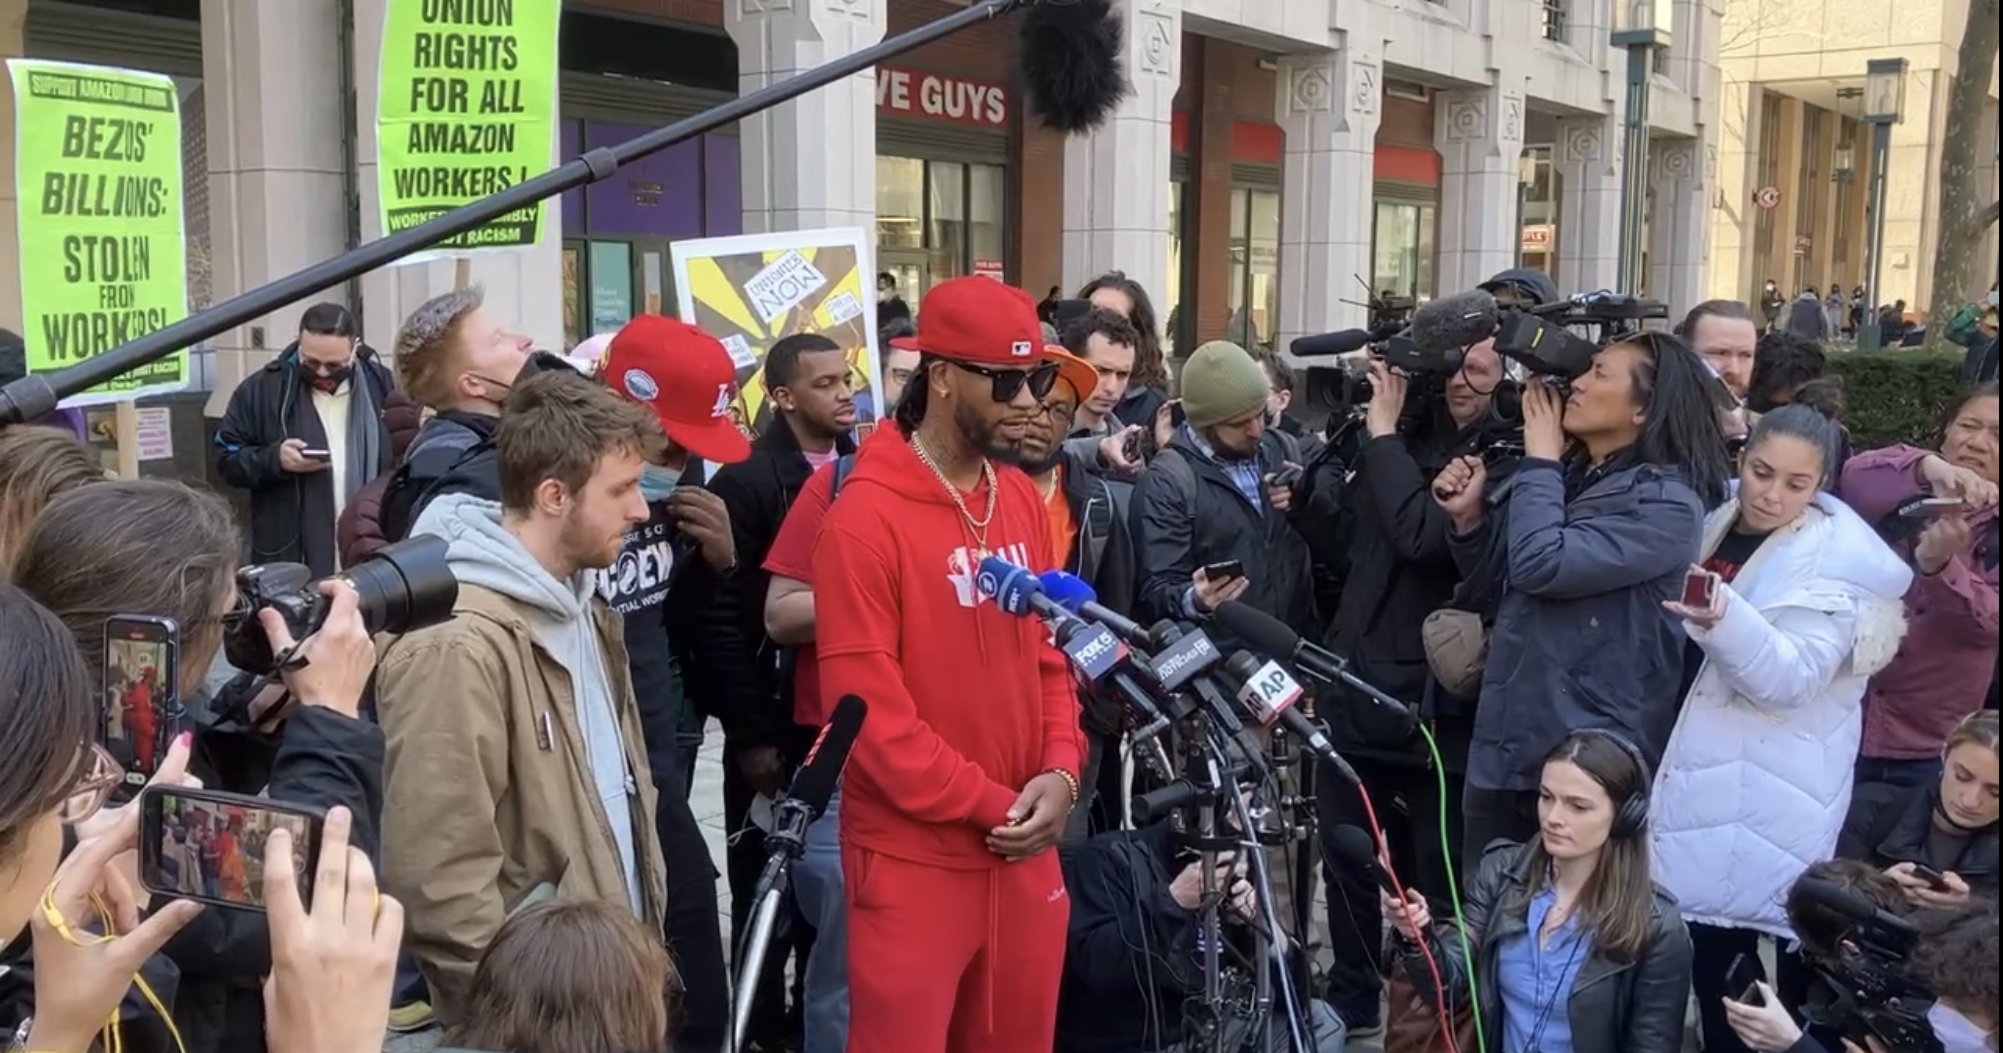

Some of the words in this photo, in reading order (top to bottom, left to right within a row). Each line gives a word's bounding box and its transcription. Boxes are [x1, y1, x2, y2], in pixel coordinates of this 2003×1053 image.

[421, 0, 513, 26] UNION
[414, 32, 518, 71] RIGHTS
[410, 77, 469, 113] FOR
[478, 79, 525, 114] ALL
[876, 69, 910, 110] VE
[920, 75, 1005, 123] GUYS
[62, 114, 154, 163] BEZOS'
[407, 122, 515, 154] AMAZON
[41, 171, 168, 217] BILLIONS:
[467, 228, 521, 244] RACISM
[63, 235, 150, 284] STOLEN
[758, 265, 818, 317] NOW
[1260, 669, 1286, 700] AP
